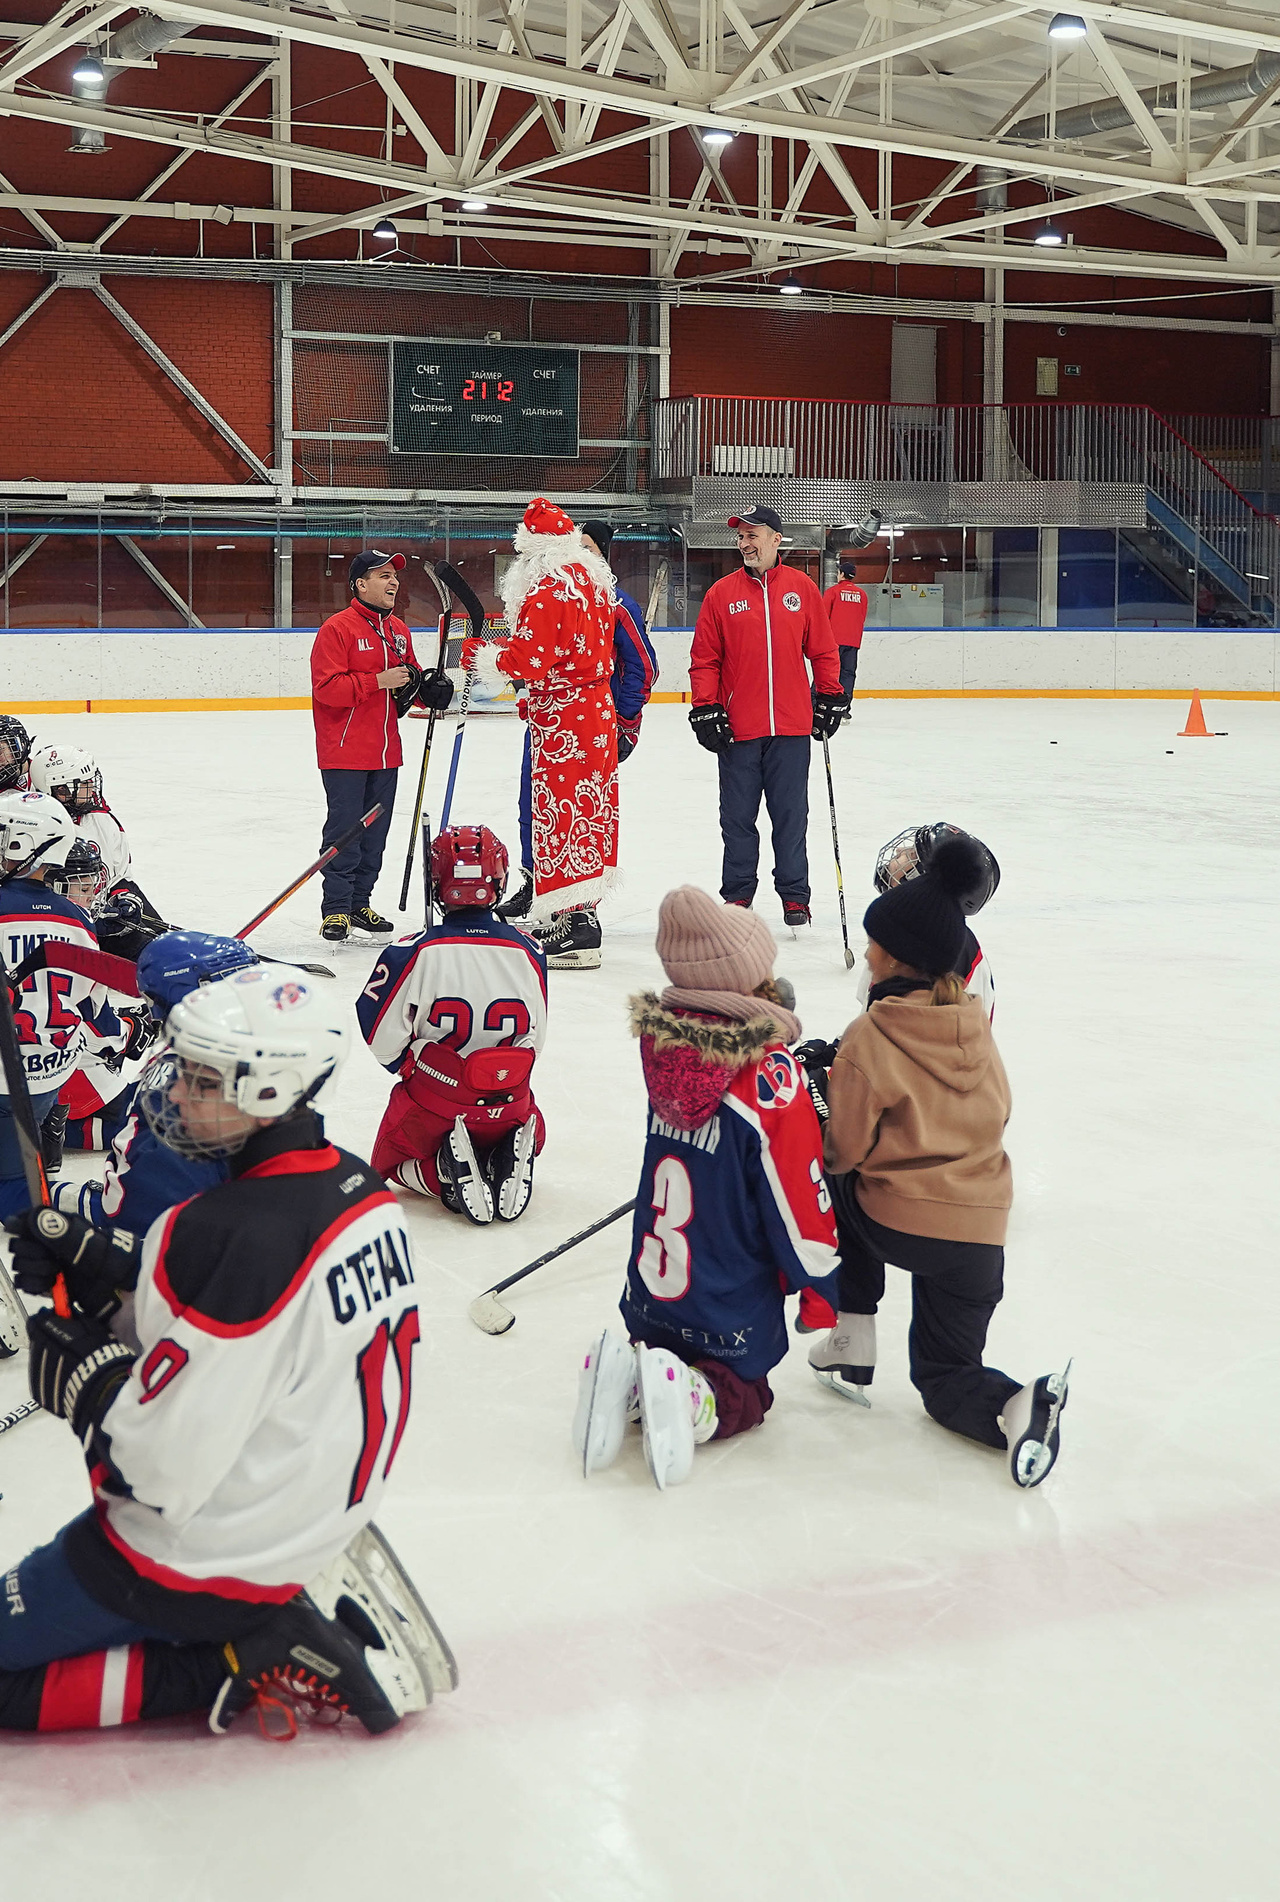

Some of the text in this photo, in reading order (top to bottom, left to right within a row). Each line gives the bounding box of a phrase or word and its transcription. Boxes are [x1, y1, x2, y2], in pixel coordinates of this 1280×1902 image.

[416, 365, 441, 375] СЧЕТ
[470, 370, 503, 380] ТАЙМЕР
[533, 369, 556, 379] СЧЕТ
[409, 404, 453, 413] УДАЛЕНИЯ
[521, 408, 563, 416] УДАЛЕНИЯ
[470, 414, 503, 424] ПЕРИОД
[840, 592, 861, 604] VIKHR
[728, 599, 751, 615] G.SH.
[163, 967, 190, 977] BAUER
[416, 1058, 459, 1088] WARRIOR
[636, 1153, 695, 1302] 3
